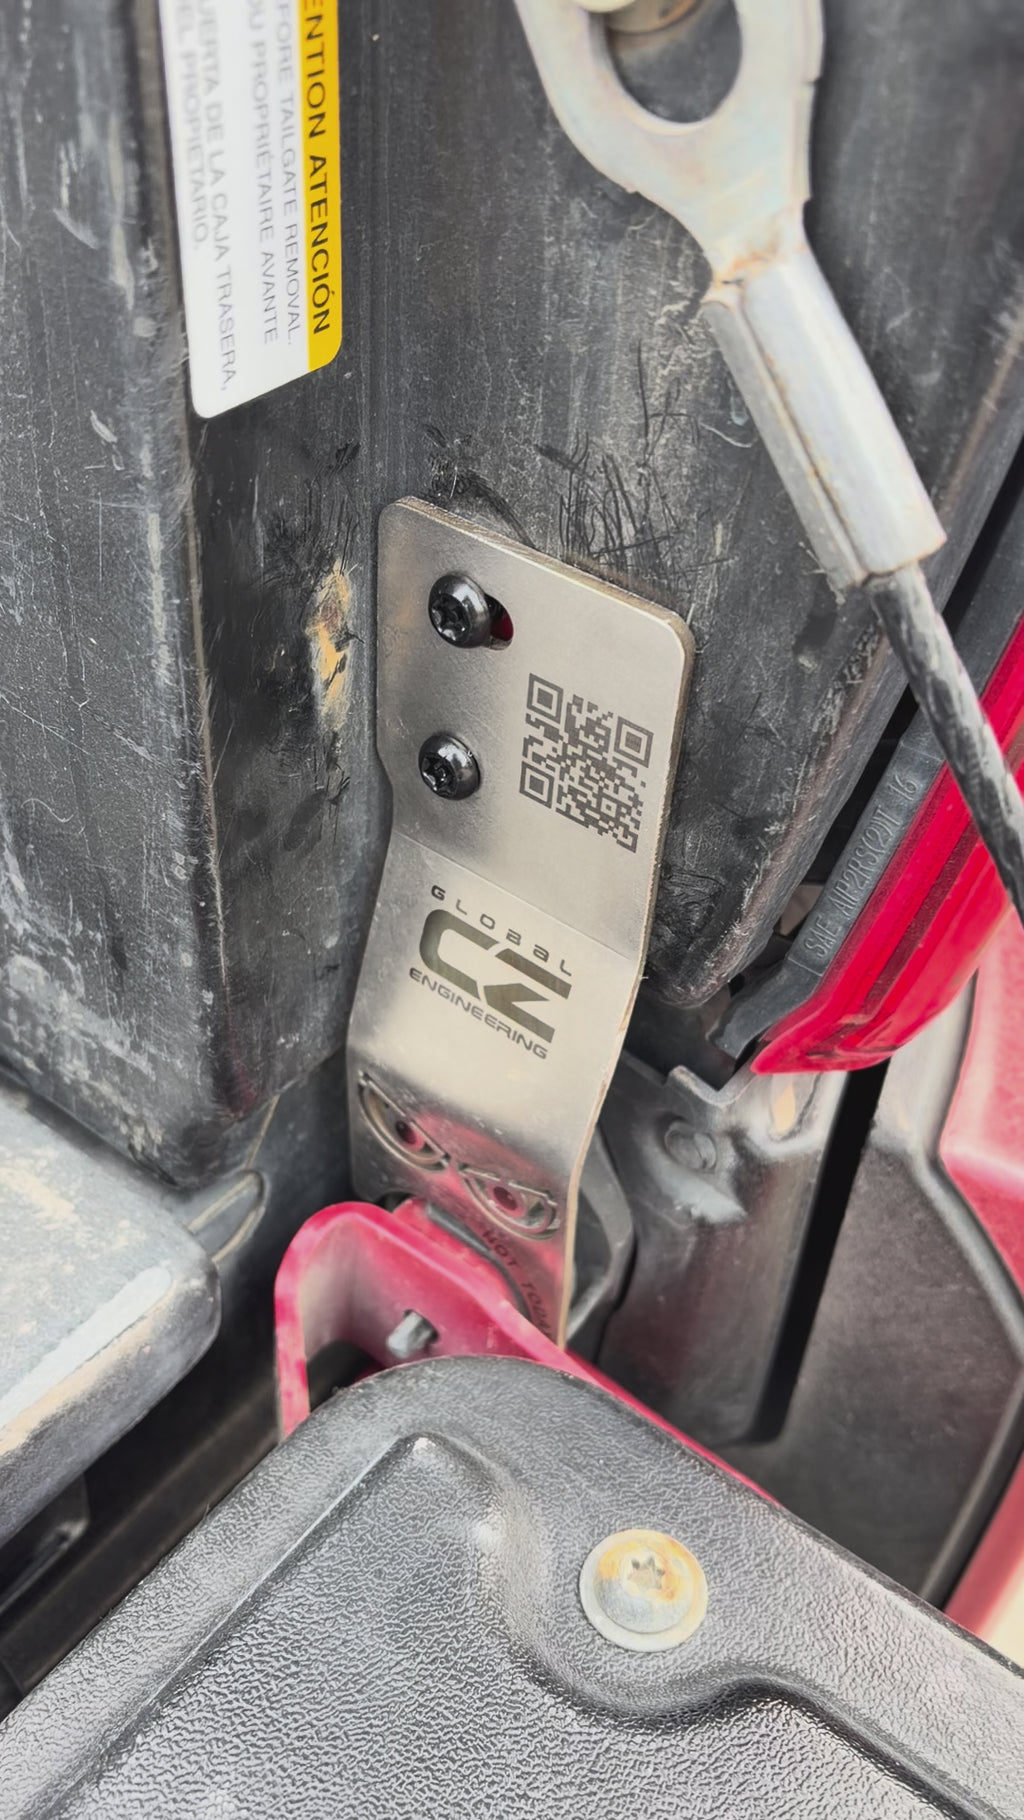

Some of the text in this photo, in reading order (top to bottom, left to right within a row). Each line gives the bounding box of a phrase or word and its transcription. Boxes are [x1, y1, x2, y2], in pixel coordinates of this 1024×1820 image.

[180, 50, 210, 252] PROPIETARIO.
[205, 100, 225, 145] DE
[207, 149, 227, 188] LA
[250, 40, 275, 244] PROPRIÉTAIRE
[279, 91, 299, 217] TAILGATE
[210, 192, 232, 263] CAJA
[284, 222, 301, 346] REMOVAL.
[309, 154, 336, 335] ATENCIÓN
[215, 264, 238, 392] TRASERA,
[260, 250, 280, 345] AVANTE
[802, 914, 844, 959] SAE
[888, 774, 920, 802] 16
[408, 966, 550, 1061] ENGINEERING
